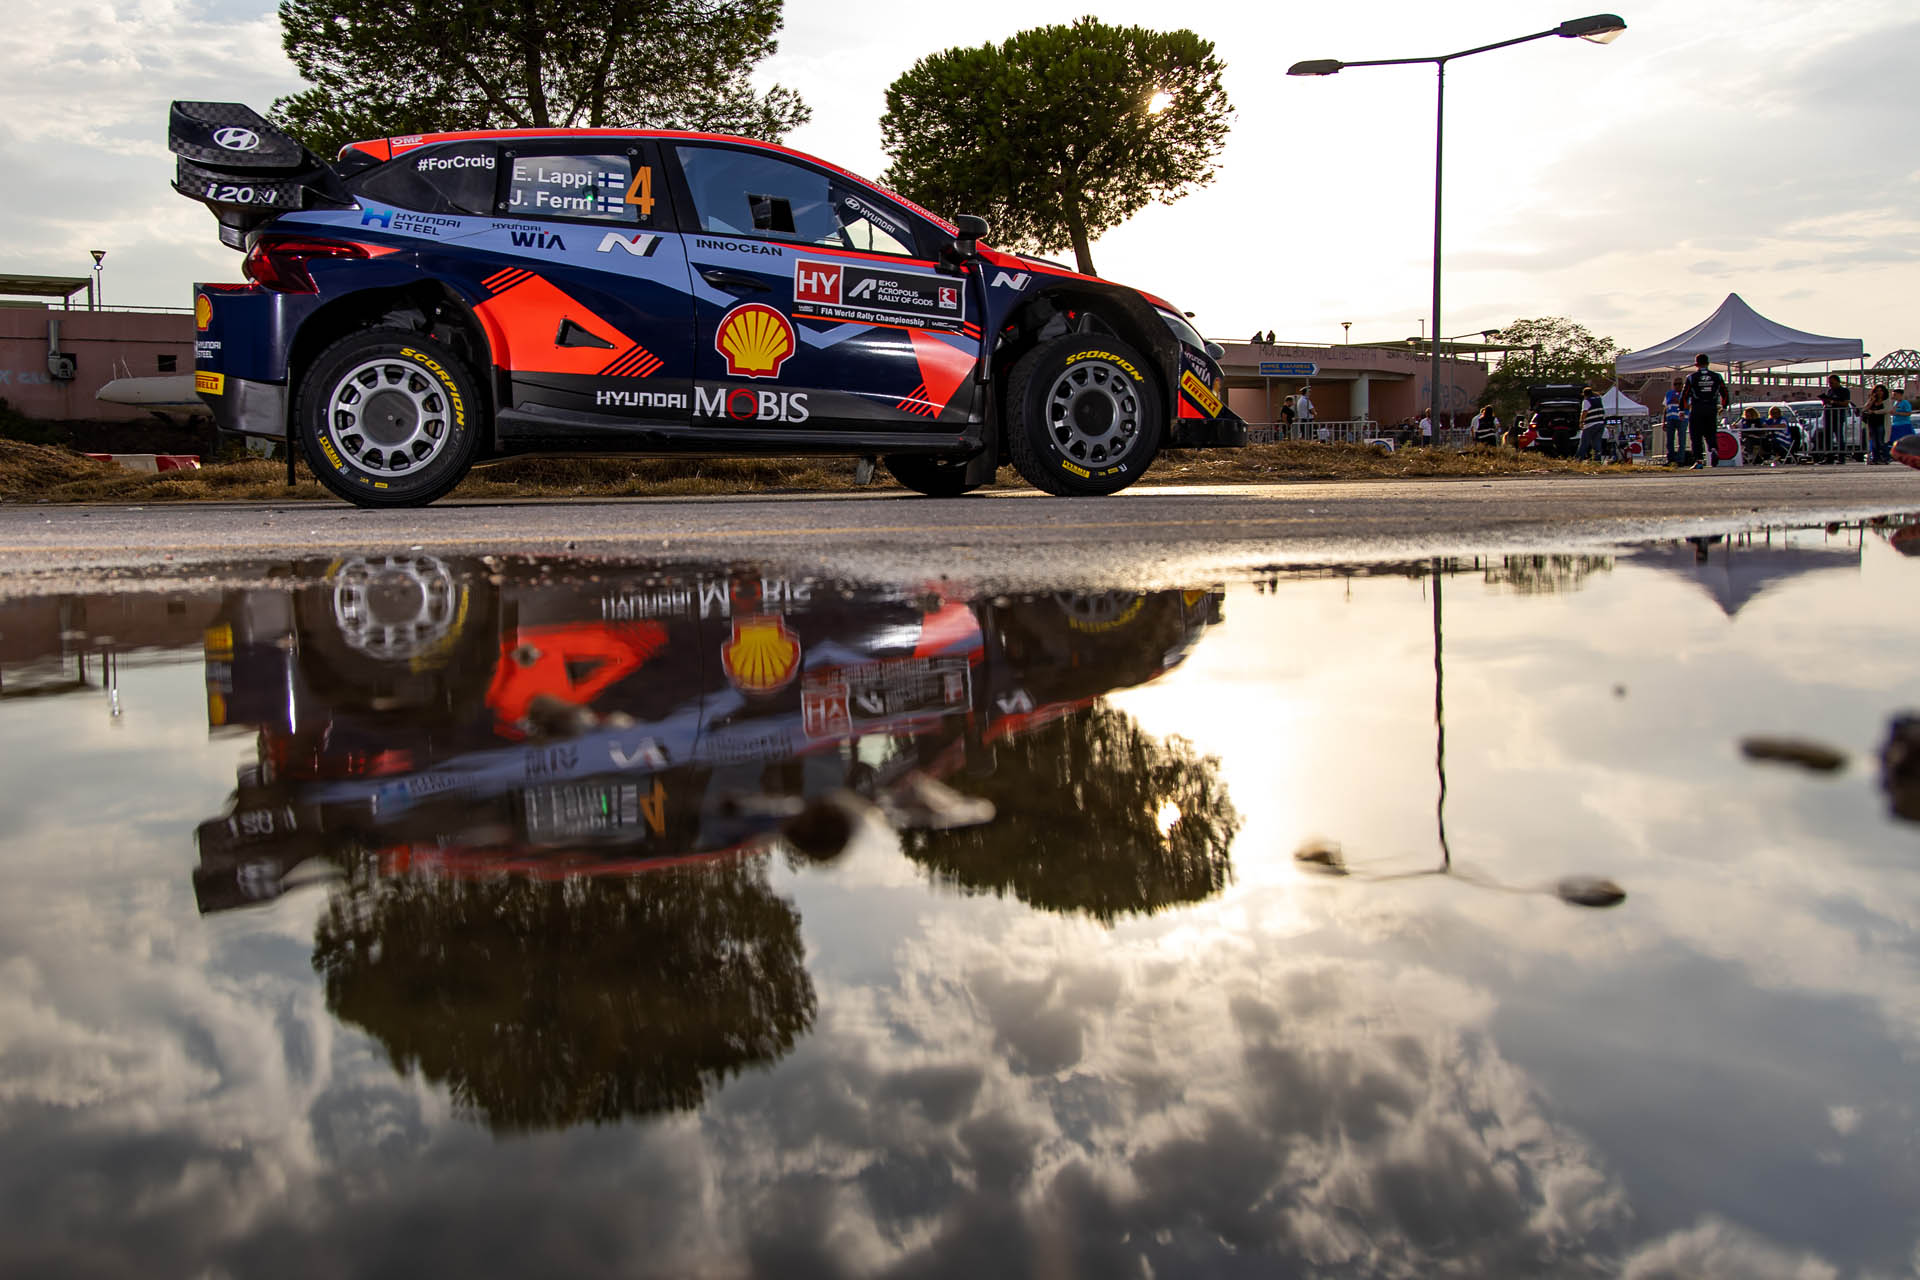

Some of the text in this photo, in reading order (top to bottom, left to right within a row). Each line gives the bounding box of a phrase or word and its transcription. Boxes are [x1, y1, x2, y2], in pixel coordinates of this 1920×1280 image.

[391, 136, 422, 145] OMP
[417, 154, 495, 172] #ForCraig
[513, 166, 592, 188] E. Lappi
[509, 190, 592, 210] J. Ferm
[625, 166, 655, 215] 4
[393, 221, 440, 236] STEEL
[396, 213, 461, 229] HYUNDAI
[492, 223, 541, 231] HYUNDAI
[860, 207, 896, 234] HYUNDAI
[511, 231, 566, 250] WIA
[696, 239, 782, 256] INNOCEAN
[799, 270, 838, 295] HY
[878, 280, 898, 288] EKO
[877, 294, 900, 302] RALLY
[878, 287, 919, 298] ACROPOLIS
[820, 307, 924, 327] FIA World Rally Championship
[1066, 350, 1144, 381] SCORPION
[400, 348, 464, 426] SCORPION
[1184, 376, 1219, 413] PIRELLI
[596, 390, 687, 409] HYUNDAI
[692, 386, 810, 423] MOBIS
